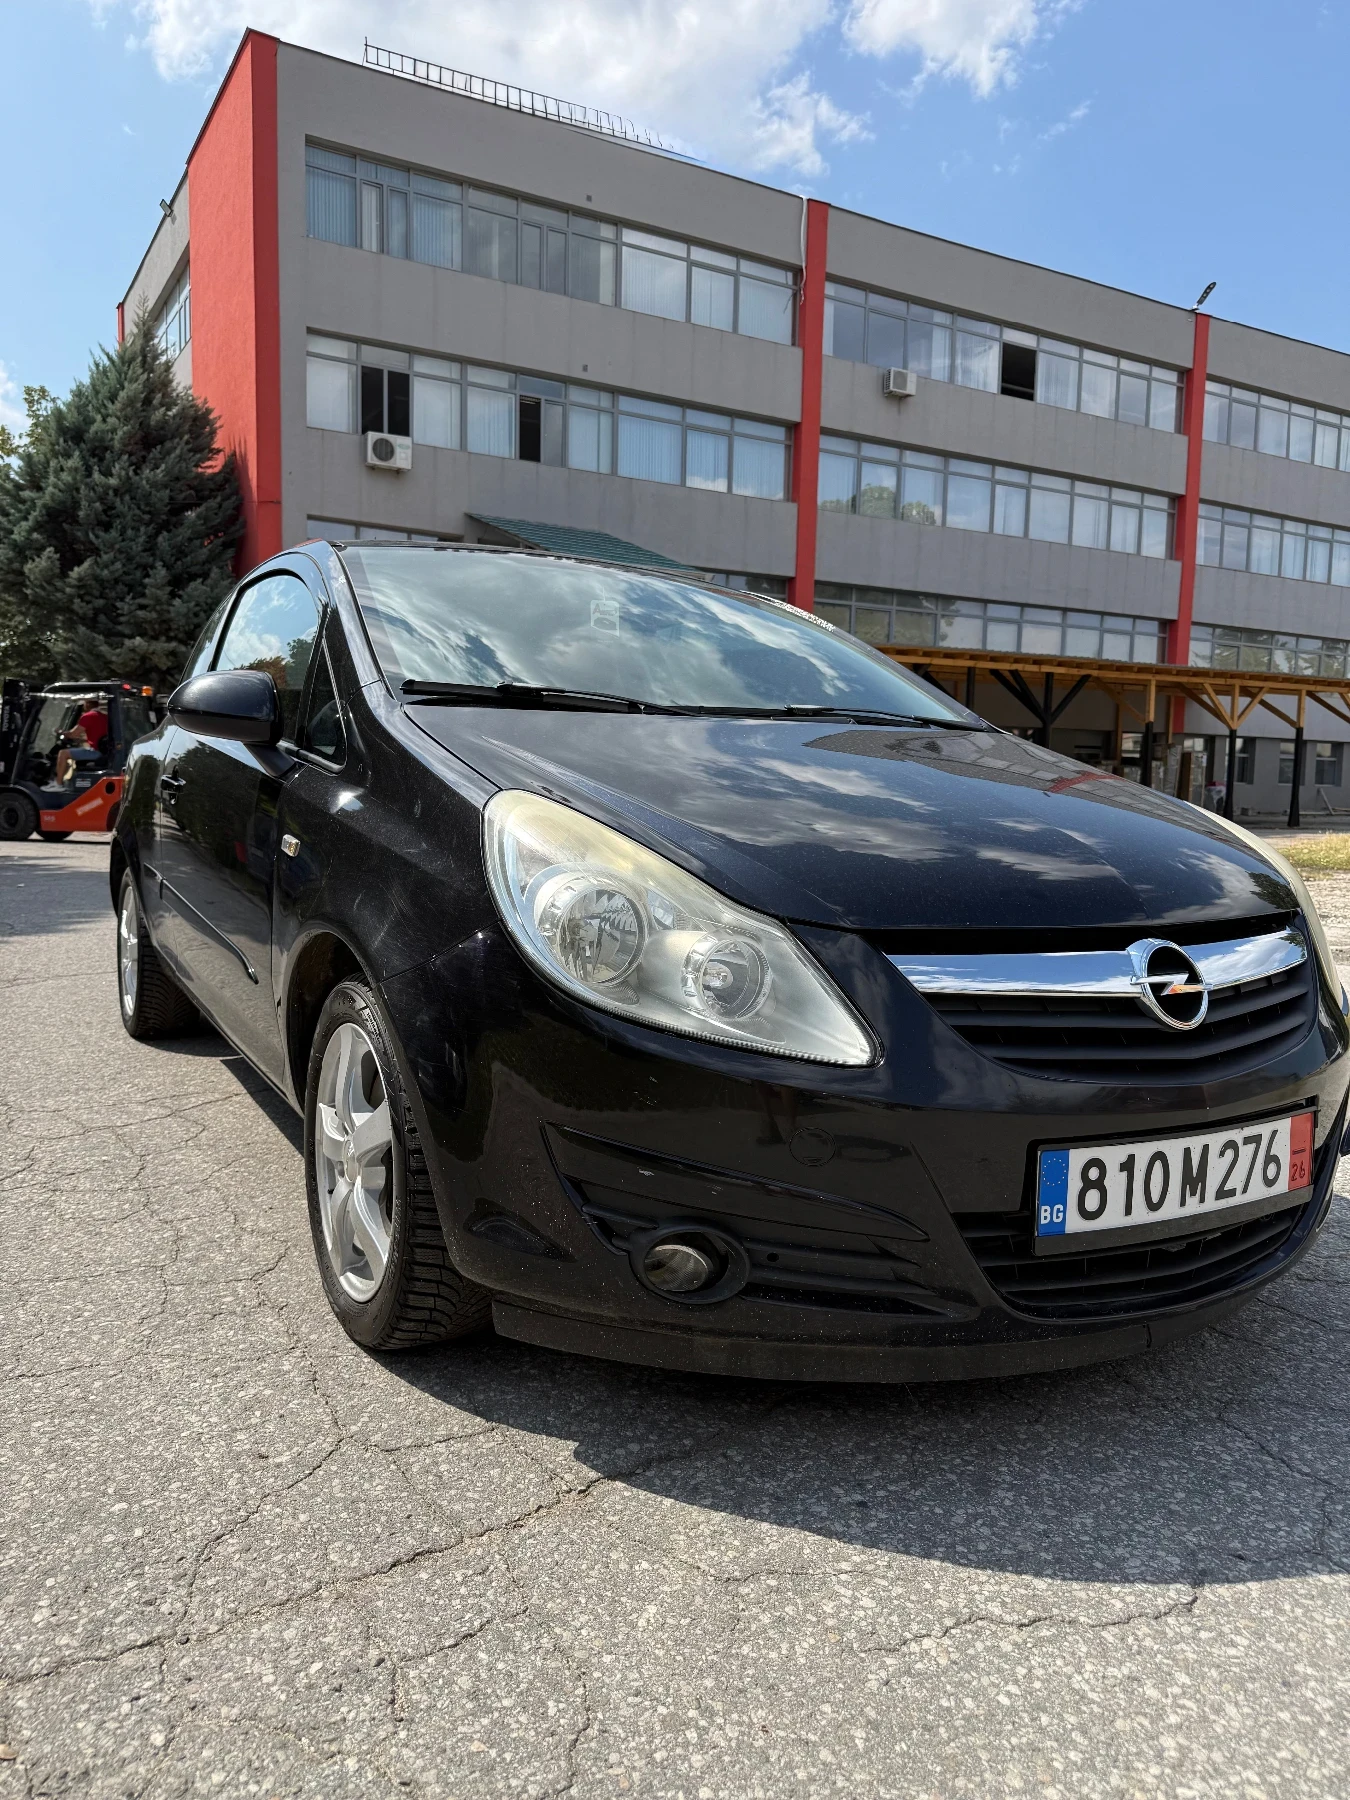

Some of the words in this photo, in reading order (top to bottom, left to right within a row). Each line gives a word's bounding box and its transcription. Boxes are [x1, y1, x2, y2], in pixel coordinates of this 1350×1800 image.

[2, 705, 10, 731] TOYOTA
[1291, 1160, 1306, 1181] 26
[1040, 1204, 1064, 1225] BG
